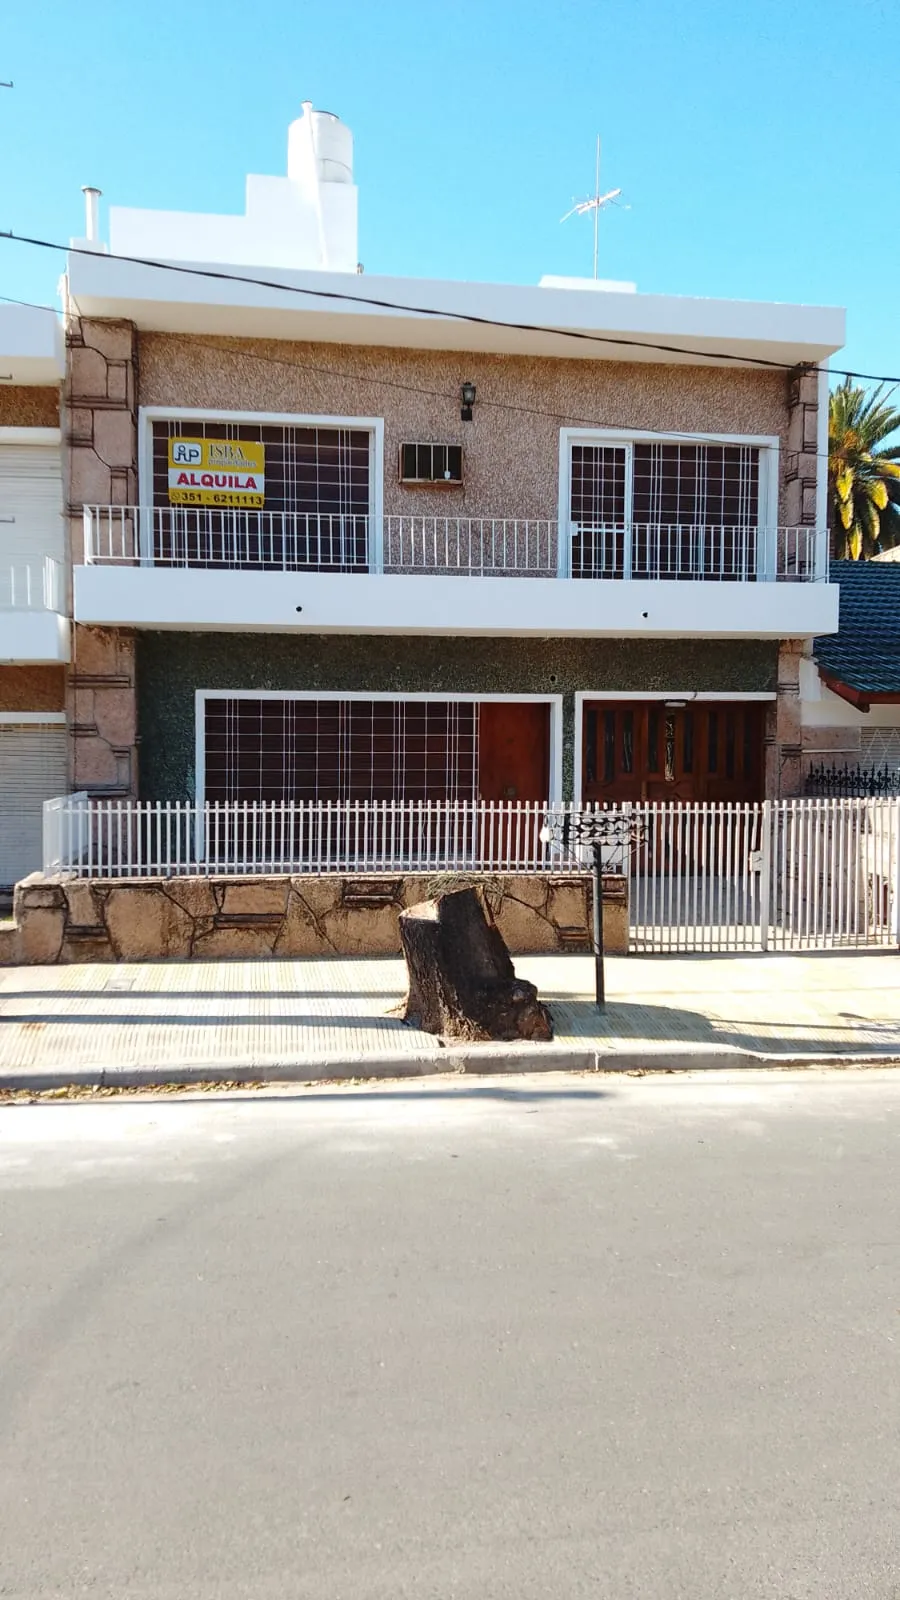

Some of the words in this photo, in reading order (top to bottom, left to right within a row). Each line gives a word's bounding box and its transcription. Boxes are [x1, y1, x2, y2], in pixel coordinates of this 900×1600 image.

[208, 443, 245, 459] ISBA
[177, 472, 258, 490] ALQUILA
[182, 492, 202, 502] 351
[213, 495, 262, 504] 6211113
